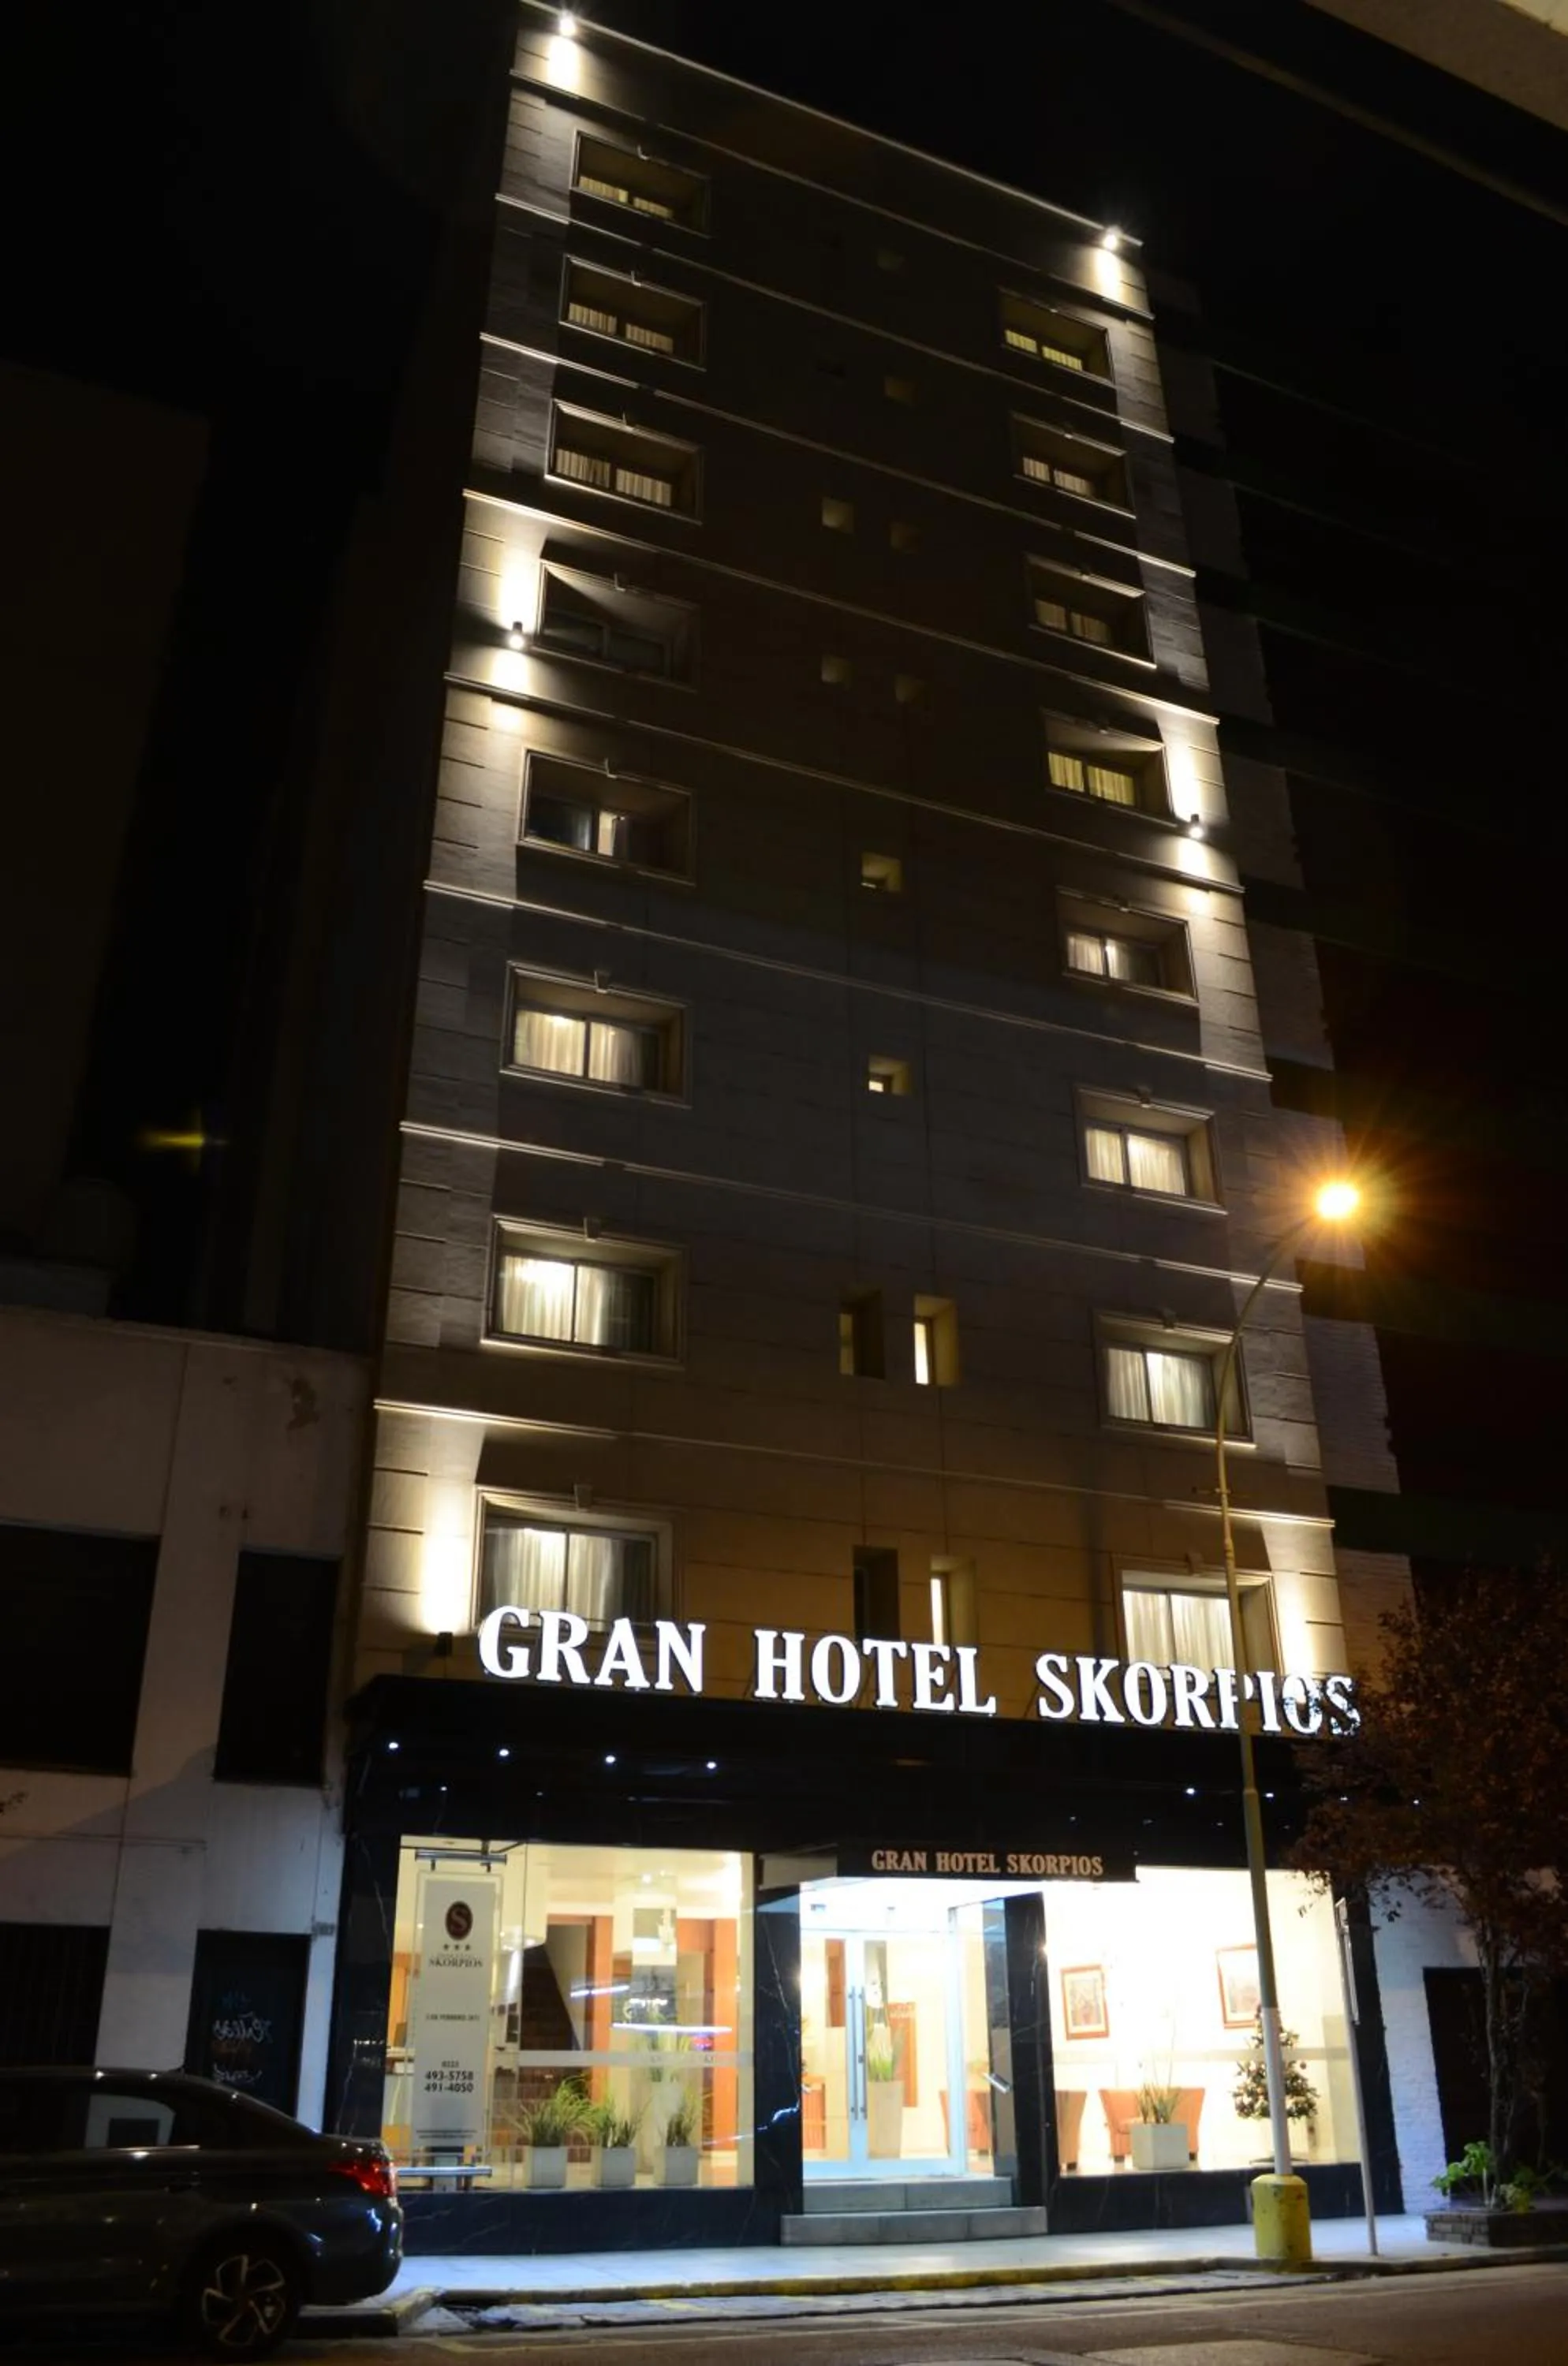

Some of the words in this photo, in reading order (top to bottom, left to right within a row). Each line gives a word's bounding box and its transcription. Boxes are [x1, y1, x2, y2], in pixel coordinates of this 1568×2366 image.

[478, 1604, 707, 1692] GRAN
[753, 1628, 997, 1715] HOTEL
[871, 1850, 928, 1872] GRAN
[935, 1852, 1000, 1874] HOTEL
[1006, 1854, 1103, 1875] SKORPIOS
